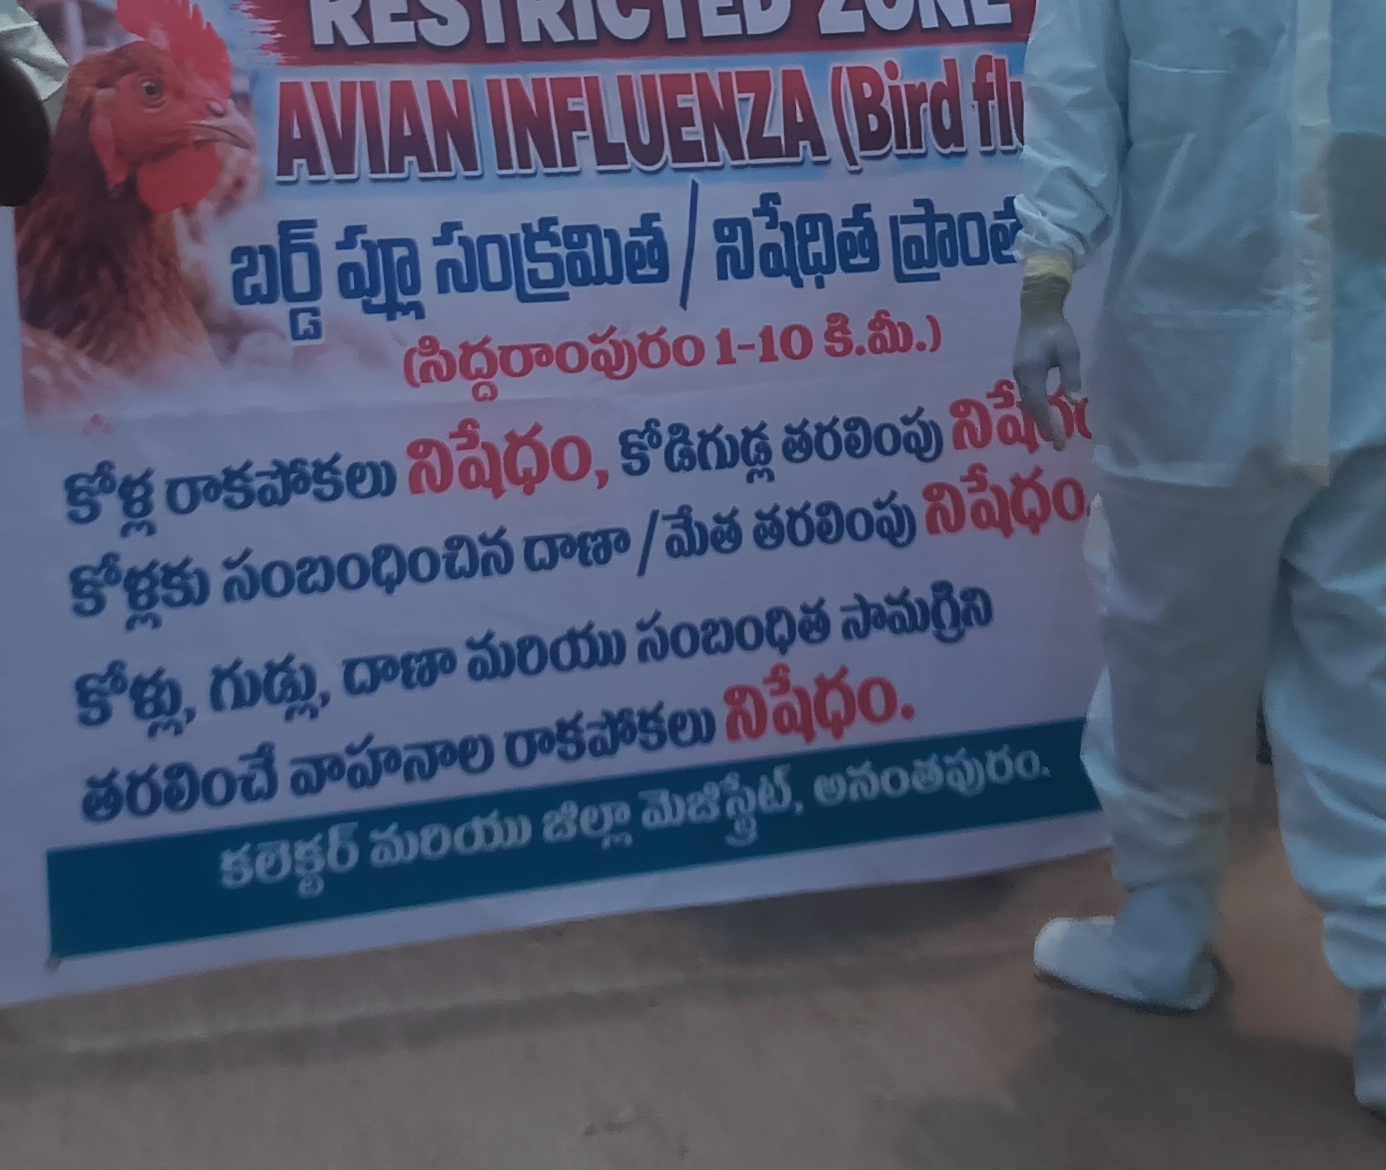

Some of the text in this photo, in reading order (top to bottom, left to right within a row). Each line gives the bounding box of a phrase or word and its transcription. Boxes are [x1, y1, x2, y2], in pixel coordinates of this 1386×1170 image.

[275, 78, 483, 181] AVIAN
[492, 68, 829, 173] INFLUENZA
[831, 58, 967, 173] (Bird
[230, 218, 323, 341] బర్డ్
[432, 212, 670, 304] సంక్రమిత
[712, 191, 881, 290] నిషేధిత
[889, 196, 1023, 284] ప్రాంత
[716, 323, 814, 366] 1-10
[823, 309, 942, 358] కి.మీ.)
[63, 460, 157, 539] కోళ్ల
[164, 452, 397, 516] రాకపోకలు
[406, 417, 610, 500] నిషేధం,
[618, 418, 776, 485] కోడిగుడ్ల
[781, 406, 944, 464] తరలింపు
[68, 552, 211, 632] కోళ్లకు
[221, 526, 515, 604] సంబంధించిన
[752, 490, 917, 551] తరలింపు
[74, 660, 196, 739] కోళ్లు,
[209, 653, 331, 723] గుడ్లు,
[342, 647, 458, 697] దాణా
[464, 621, 627, 682] మరియు
[635, 597, 832, 664] సంబంధిత
[81, 663, 916, 823] తరలించే వాహనాల రాకపోకలు నిషేధం.
[220, 822, 360, 896] కలెక్టర్
[369, 809, 532, 866] మరియు
[542, 800, 633, 849] జిల్లా
[813, 745, 1050, 805] అనంతపురం.
